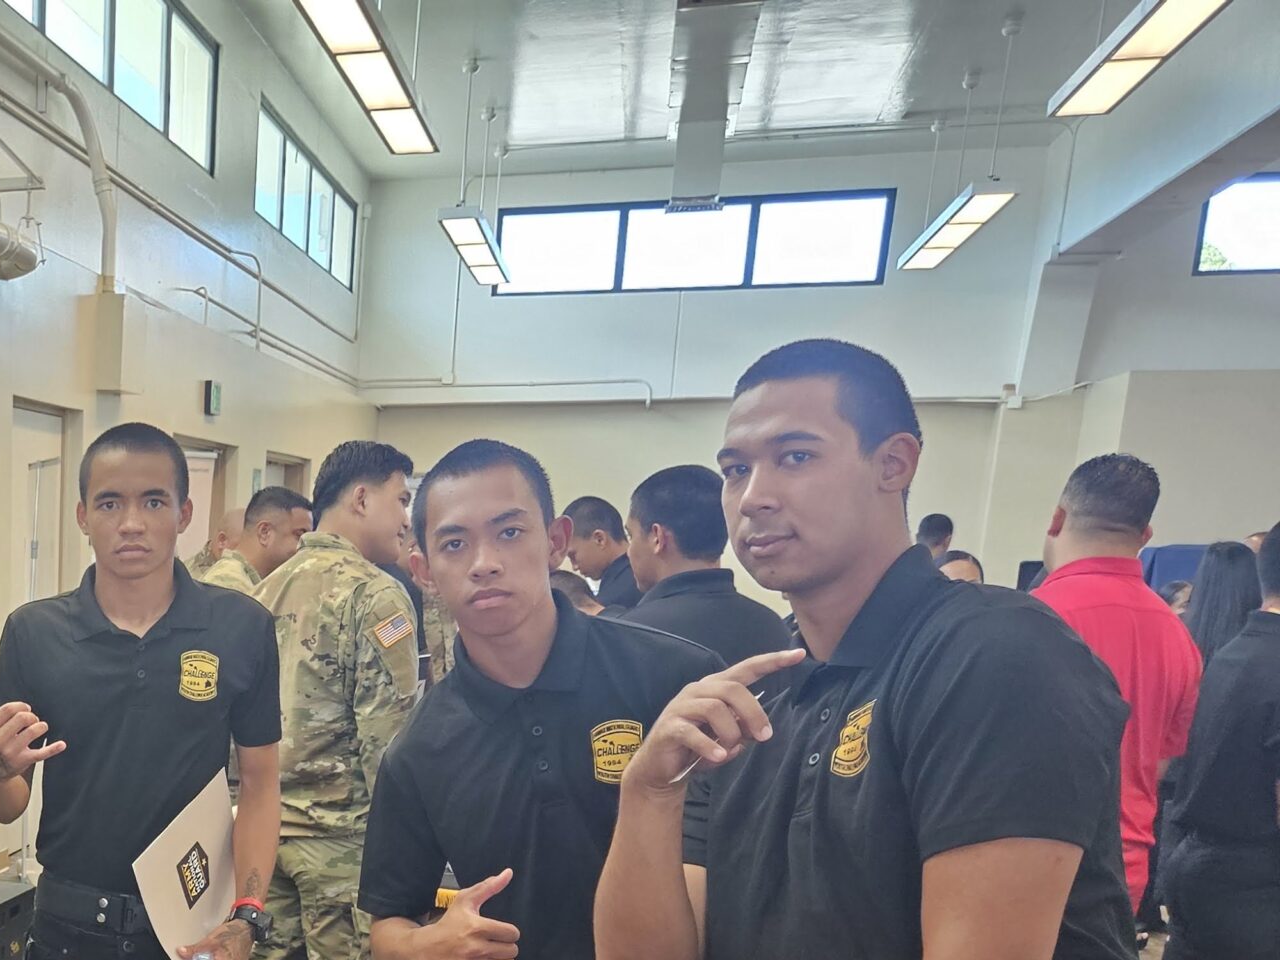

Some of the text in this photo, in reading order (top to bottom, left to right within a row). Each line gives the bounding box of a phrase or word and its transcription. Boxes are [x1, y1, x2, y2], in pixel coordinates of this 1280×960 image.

[182, 862, 197, 898] ARMY
[187, 856, 201, 893] NATIONAL
[191, 850, 206, 889] GUARD
